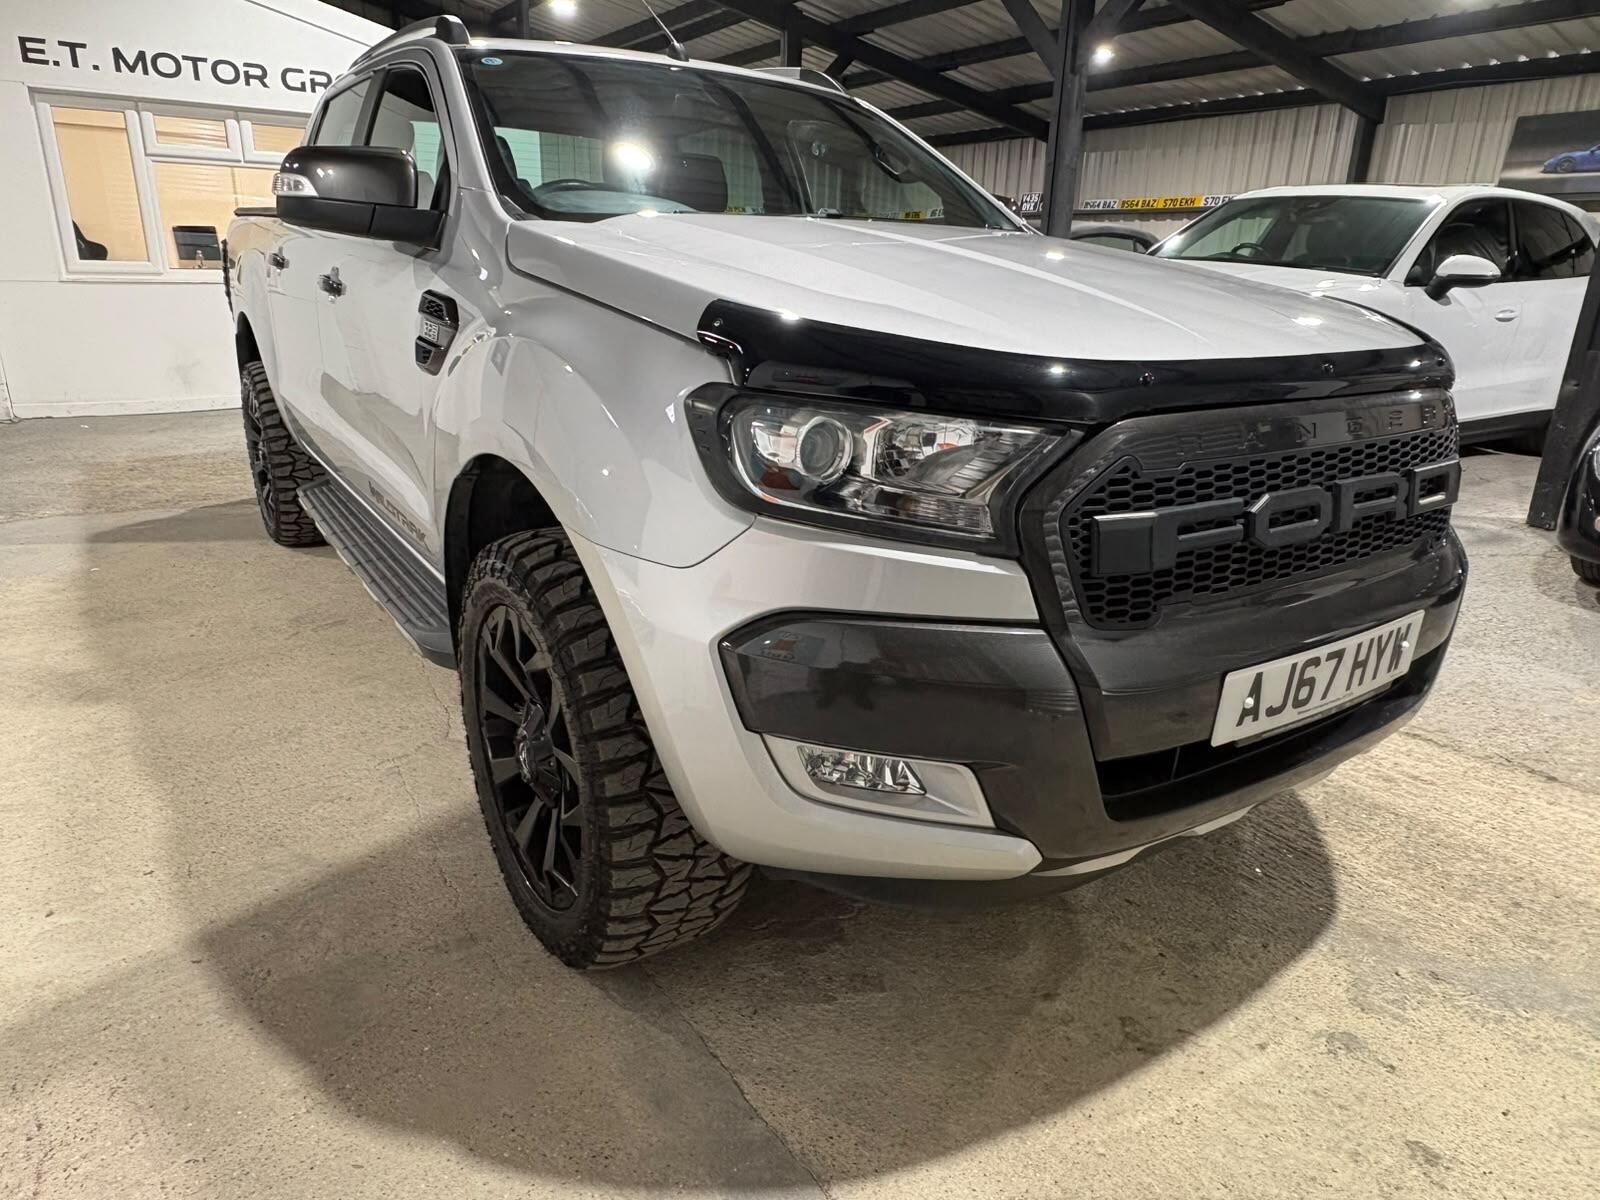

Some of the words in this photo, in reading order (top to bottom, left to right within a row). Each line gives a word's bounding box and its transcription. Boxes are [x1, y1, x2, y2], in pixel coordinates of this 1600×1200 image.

[18, 36, 100, 71] E.T.
[112, 47, 270, 89] MOTOR
[281, 67, 343, 93] GR
[1163, 198, 1179, 208] S70
[1204, 196, 1220, 206] S70
[1092, 456, 1460, 576] FORD
[1235, 648, 1346, 727] AJ67
[1345, 622, 1412, 692] HYW
